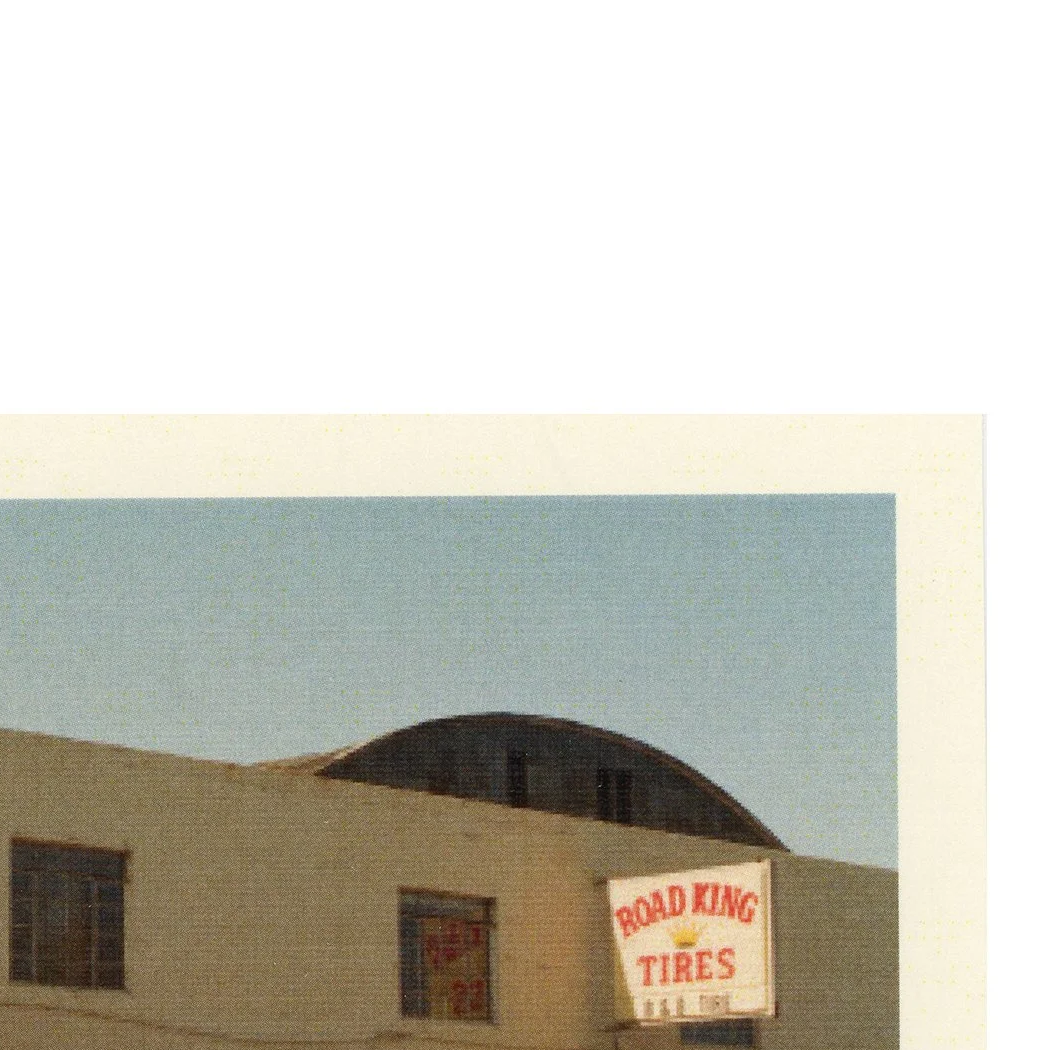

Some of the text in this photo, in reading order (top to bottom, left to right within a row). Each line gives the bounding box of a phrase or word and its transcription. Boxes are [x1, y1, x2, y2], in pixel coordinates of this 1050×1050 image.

[615, 881, 759, 939] ROAD KING
[636, 947, 736, 987] TIRES
